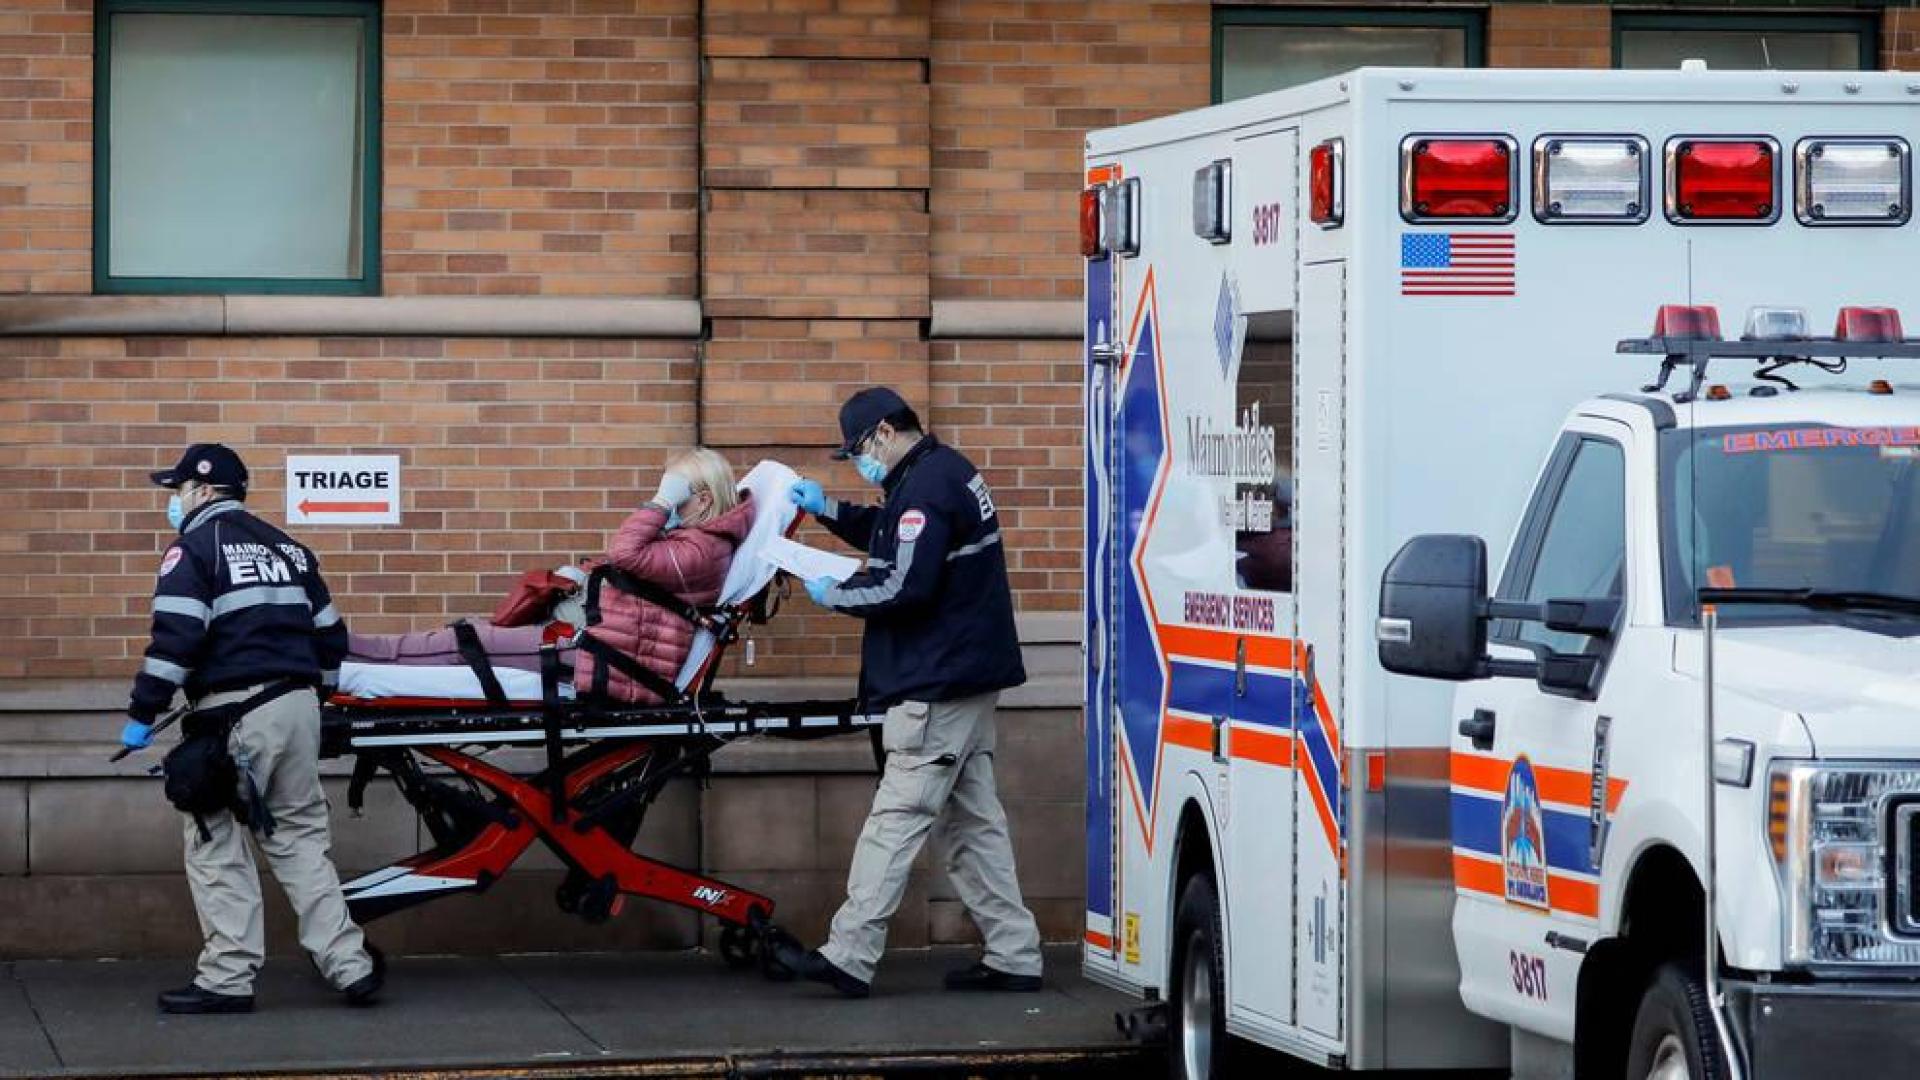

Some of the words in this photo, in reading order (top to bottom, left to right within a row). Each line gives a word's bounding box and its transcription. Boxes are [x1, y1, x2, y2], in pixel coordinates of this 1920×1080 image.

[1253, 203, 1281, 246] 3817
[294, 470, 389, 489] TRIAGE
[1184, 591, 1230, 628] EMERGENCY
[1233, 595, 1274, 633] SERVICES
[1510, 950, 1547, 1001] 3817
